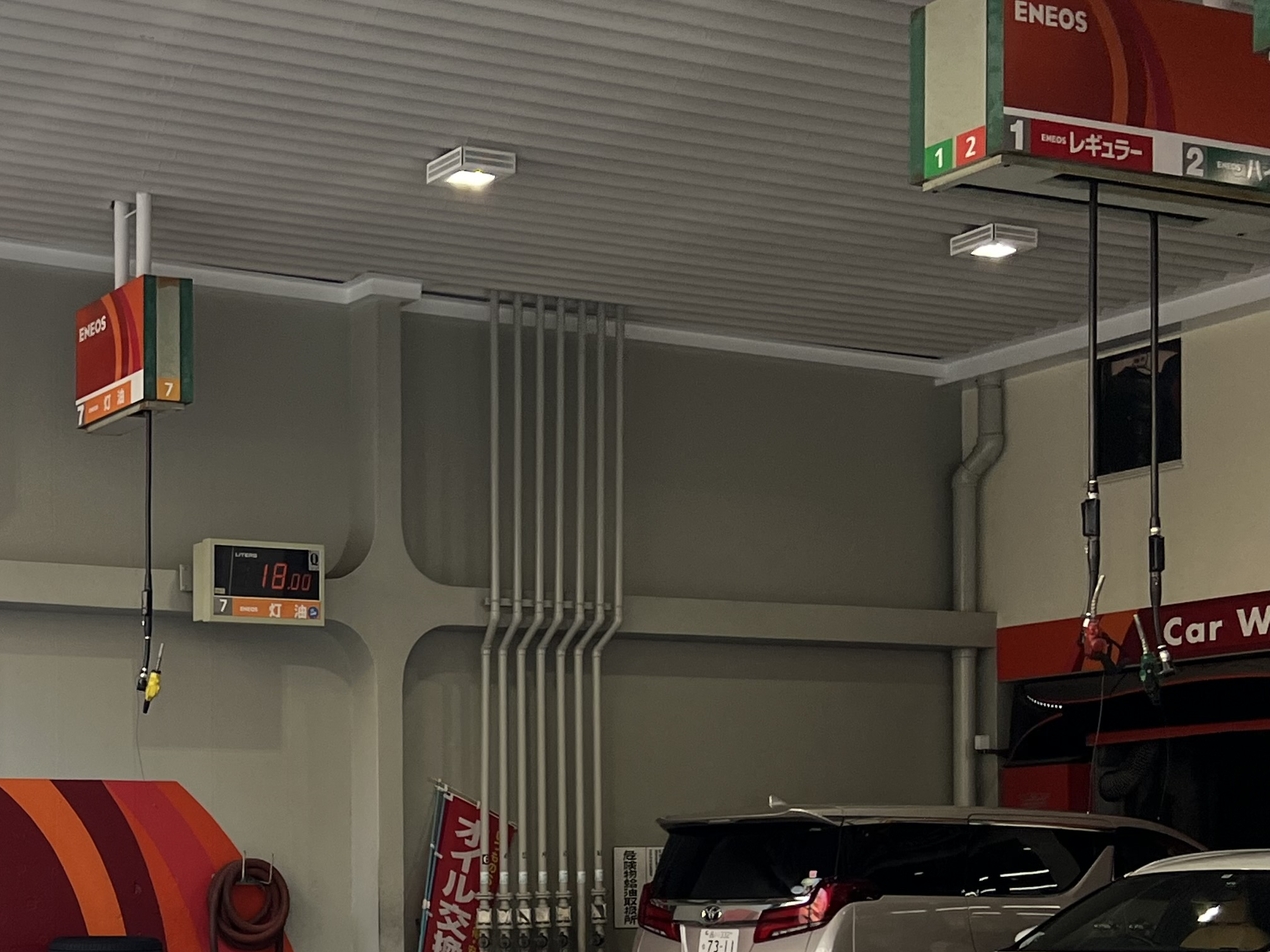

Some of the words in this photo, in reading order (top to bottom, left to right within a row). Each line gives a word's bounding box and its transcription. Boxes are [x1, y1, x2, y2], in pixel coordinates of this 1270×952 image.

[1014, 0, 1088, 33] ENEOS
[965, 136, 977, 159] 2
[1010, 119, 1024, 150] 1
[1041, 133, 1067, 145] ENEOS
[1069, 131, 1143, 161] レギュラー
[934, 147, 943, 168] 1
[1186, 147, 1204, 177] 2
[79, 315, 107, 343] ENEOS
[164, 382, 173, 397] 7
[76, 404, 84, 426] 7
[262, 562, 312, 591] 18.00
[219, 599, 228, 612] 7
[1163, 616, 1223, 646] Car
[708, 940, 735, 952] 73-11
